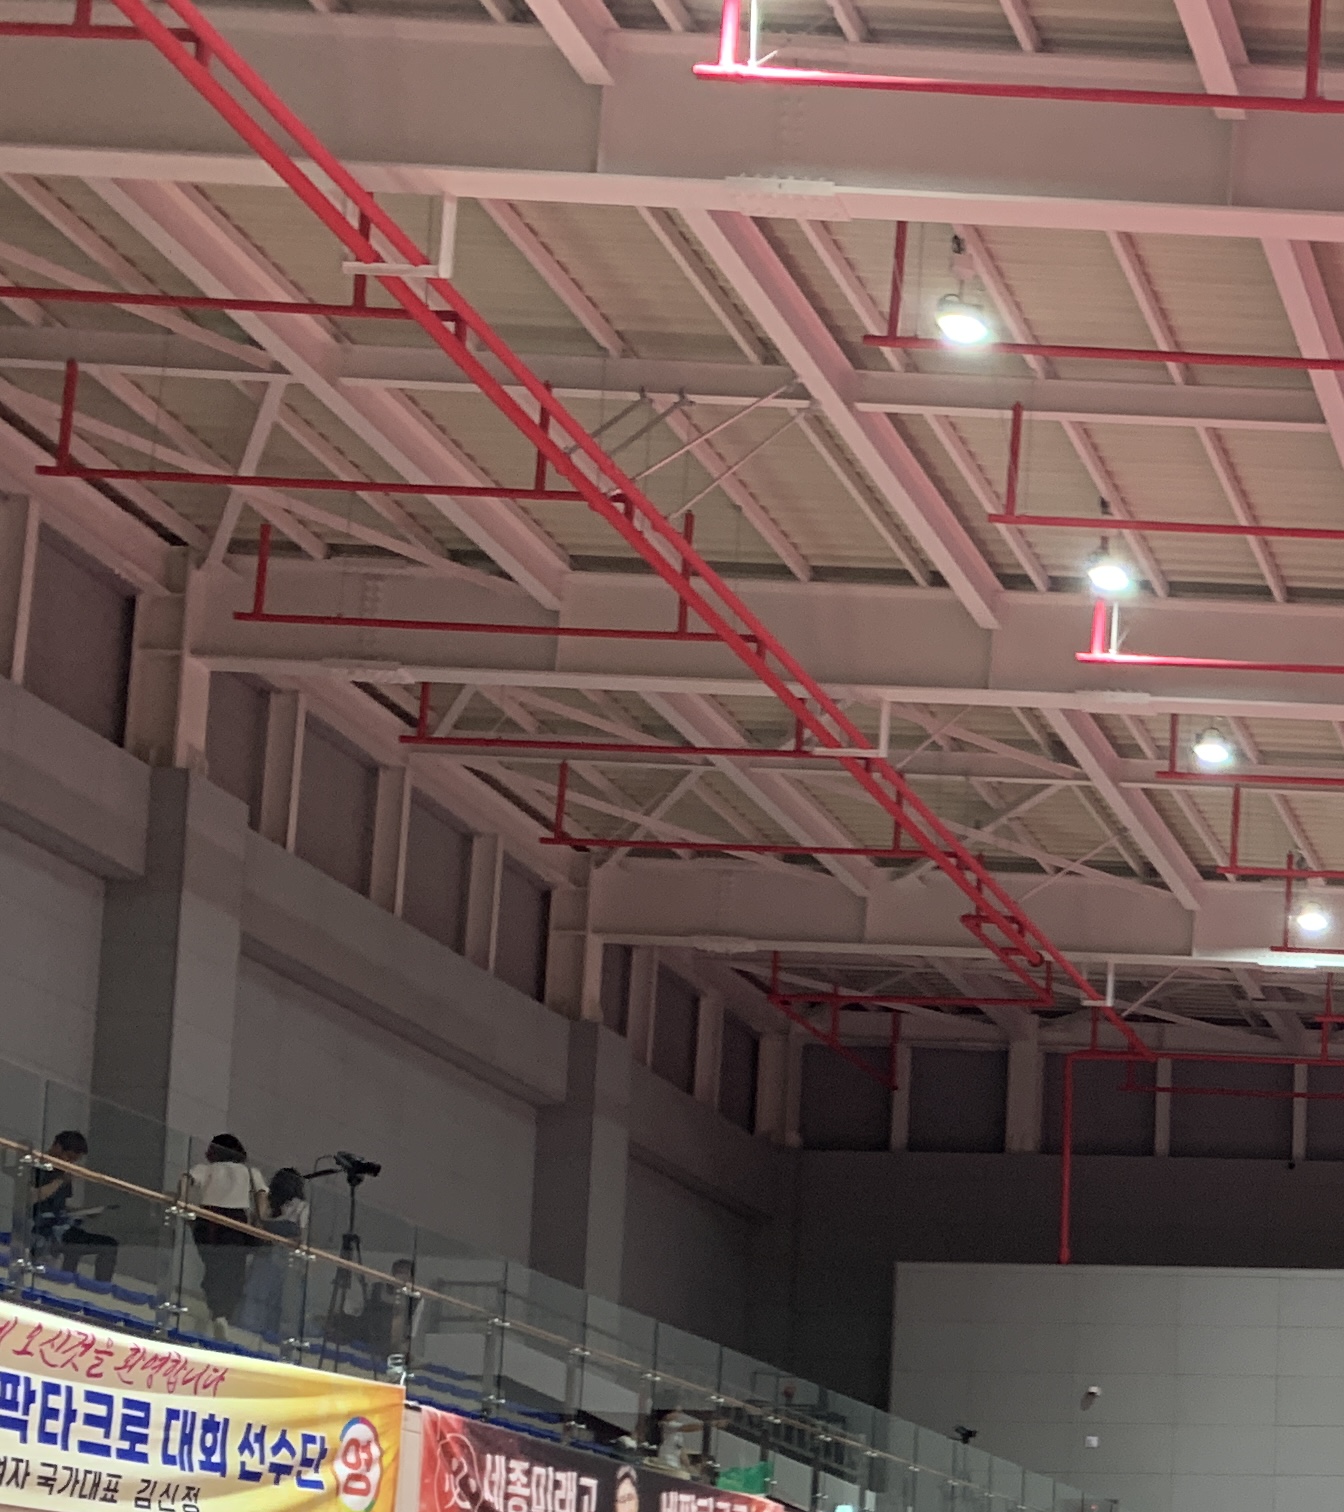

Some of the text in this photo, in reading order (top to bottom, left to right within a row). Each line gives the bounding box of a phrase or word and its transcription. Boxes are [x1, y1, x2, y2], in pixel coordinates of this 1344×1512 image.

[161, 1407, 230, 1478] 대회
[237, 1423, 328, 1490] 선수단
[37, 1462, 123, 1503] 국가대표
